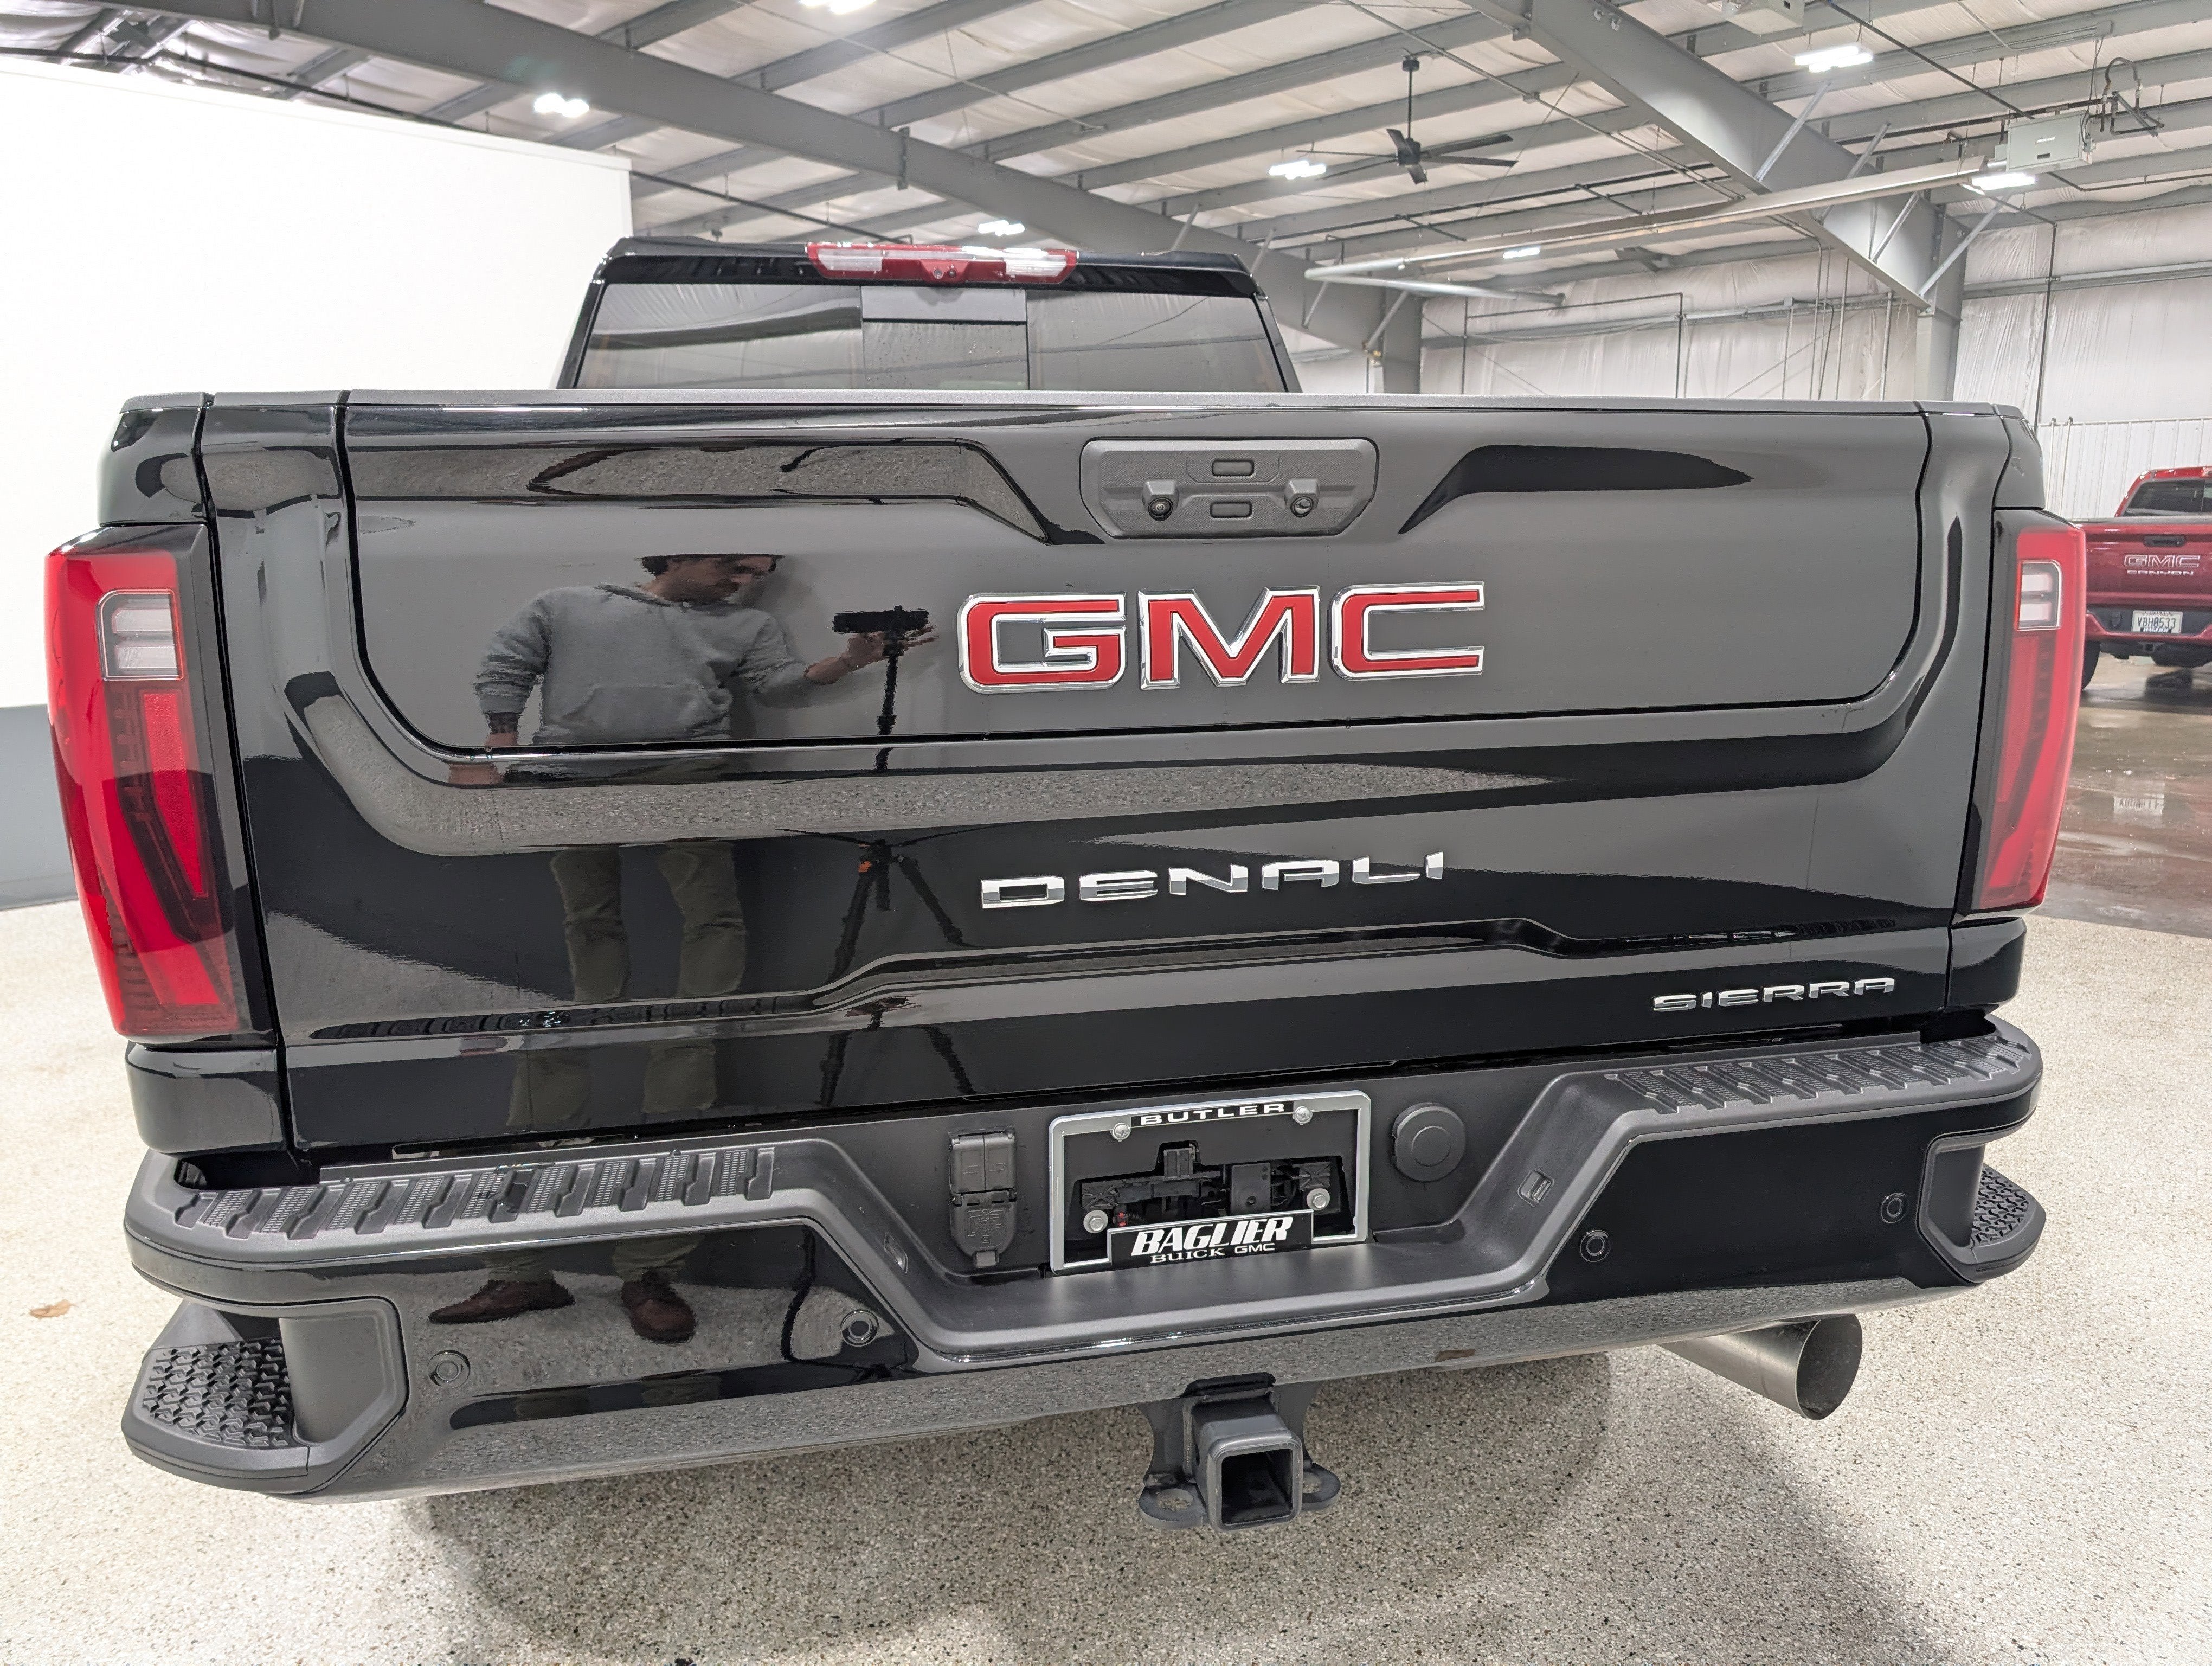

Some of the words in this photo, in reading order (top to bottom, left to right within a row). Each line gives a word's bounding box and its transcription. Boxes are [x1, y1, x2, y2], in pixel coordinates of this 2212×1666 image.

[2124, 554, 2200, 567] GMC
[957, 581, 1484, 694] GMC
[981, 851, 1444, 909] DENALI
[1653, 977, 1895, 1013] SIERRA
[1140, 1103, 1285, 1126] BUTLER
[1130, 1216, 1294, 1257] BAGLIER
[1150, 1248, 1225, 1264] BUICK
[1234, 1242, 1275, 1254] GMC
